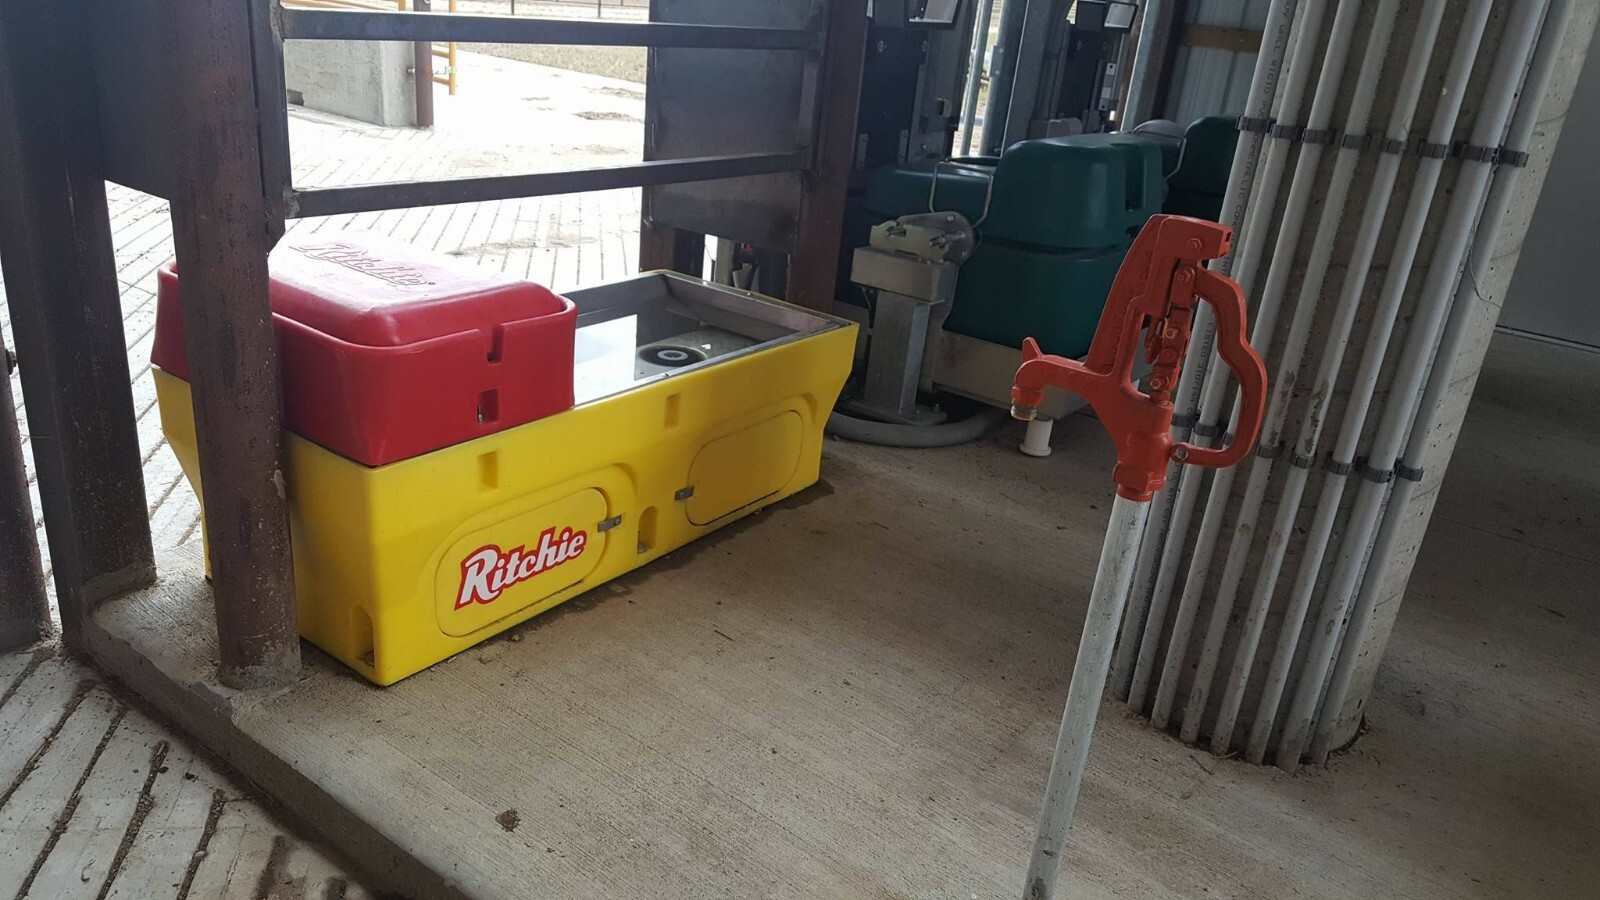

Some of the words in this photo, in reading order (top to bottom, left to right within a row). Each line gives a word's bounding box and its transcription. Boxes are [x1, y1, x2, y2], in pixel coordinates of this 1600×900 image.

[1264, 59, 1277, 94] RIGID
[1239, 133, 1259, 199] ONMETALLIC
[1200, 322, 1213, 357] LISTED
[456, 528, 586, 608] Ritchie
